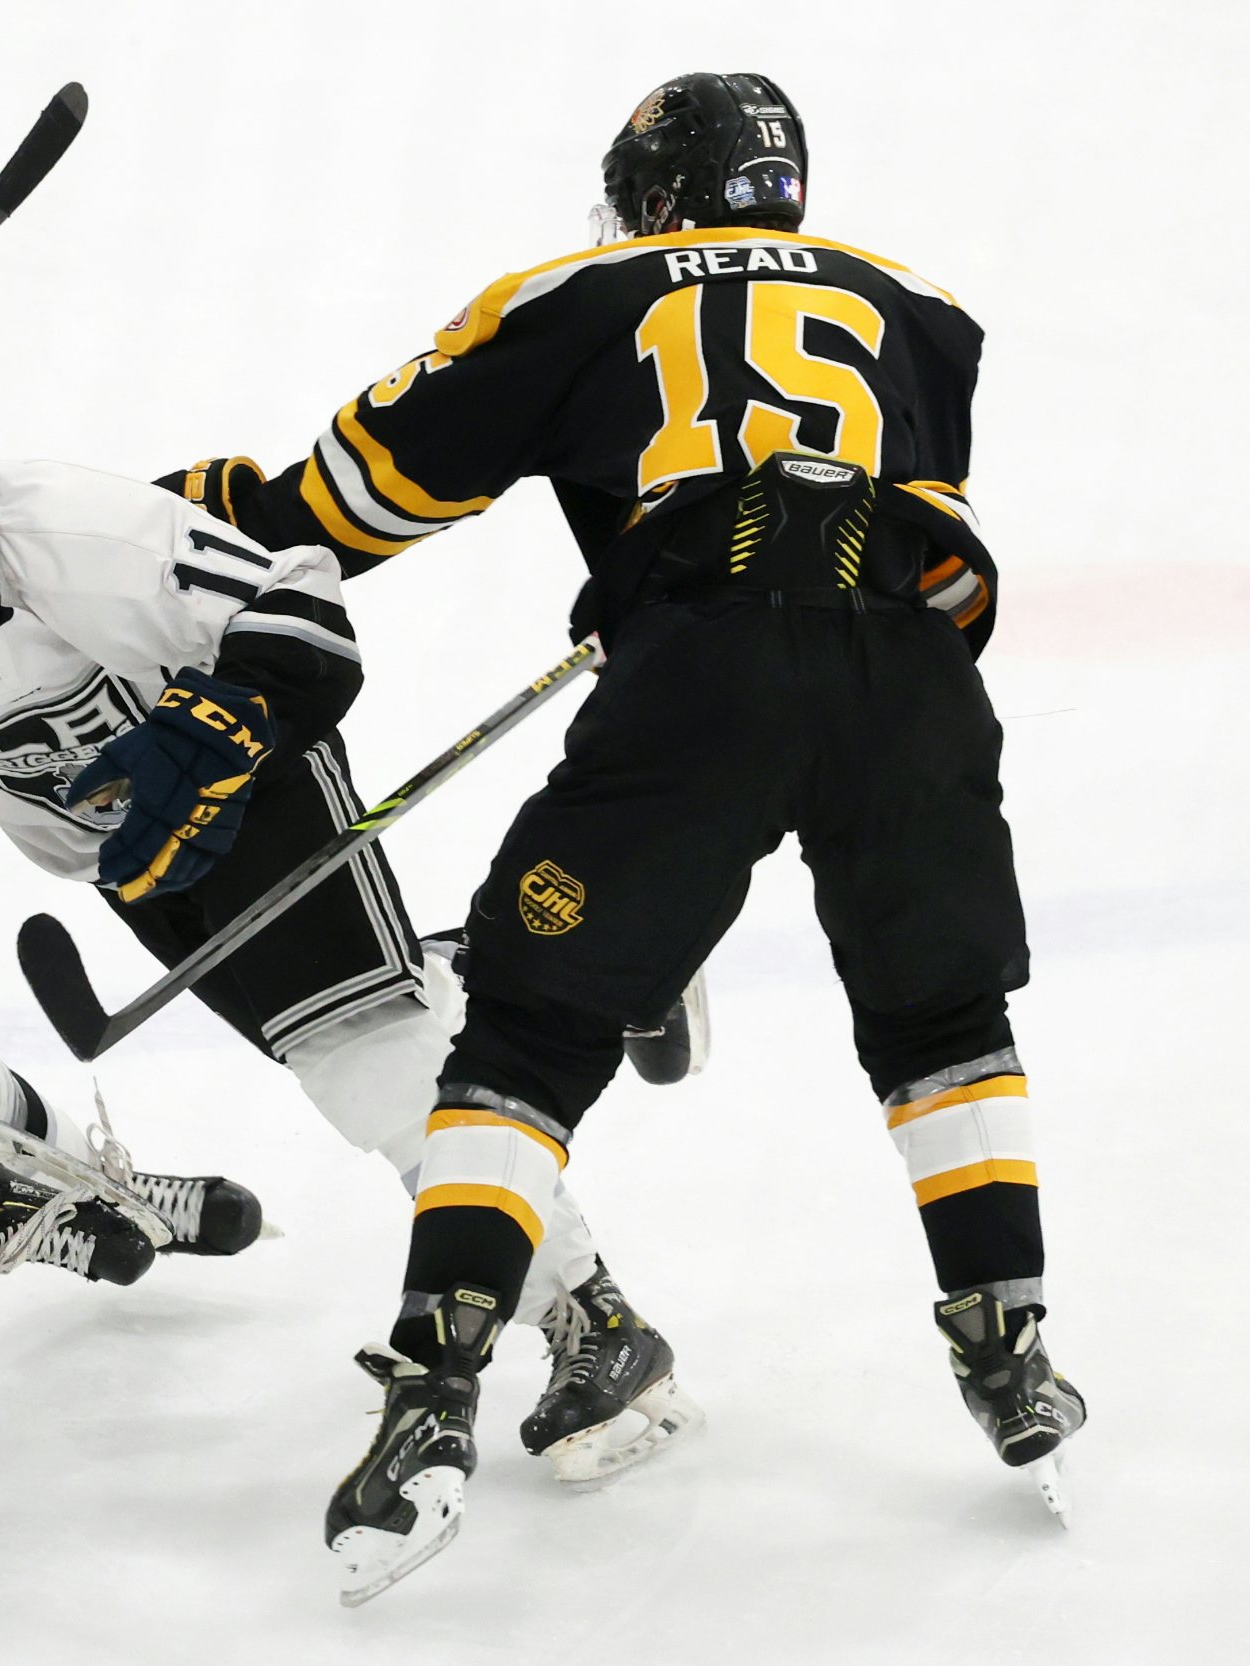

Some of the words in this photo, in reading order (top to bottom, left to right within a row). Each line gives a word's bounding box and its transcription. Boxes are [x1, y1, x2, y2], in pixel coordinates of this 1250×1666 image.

[757, 120, 786, 148] 15
[664, 248, 818, 283] READ
[634, 279, 884, 497] 15
[789, 462, 848, 480] BAUER
[170, 527, 274, 607] 11
[156, 687, 264, 758] CCM
[458, 1290, 495, 1308] CCM
[944, 1295, 979, 1315] CCM
[608, 1344, 632, 1380] BAUER
[386, 1412, 441, 1483] CCM
